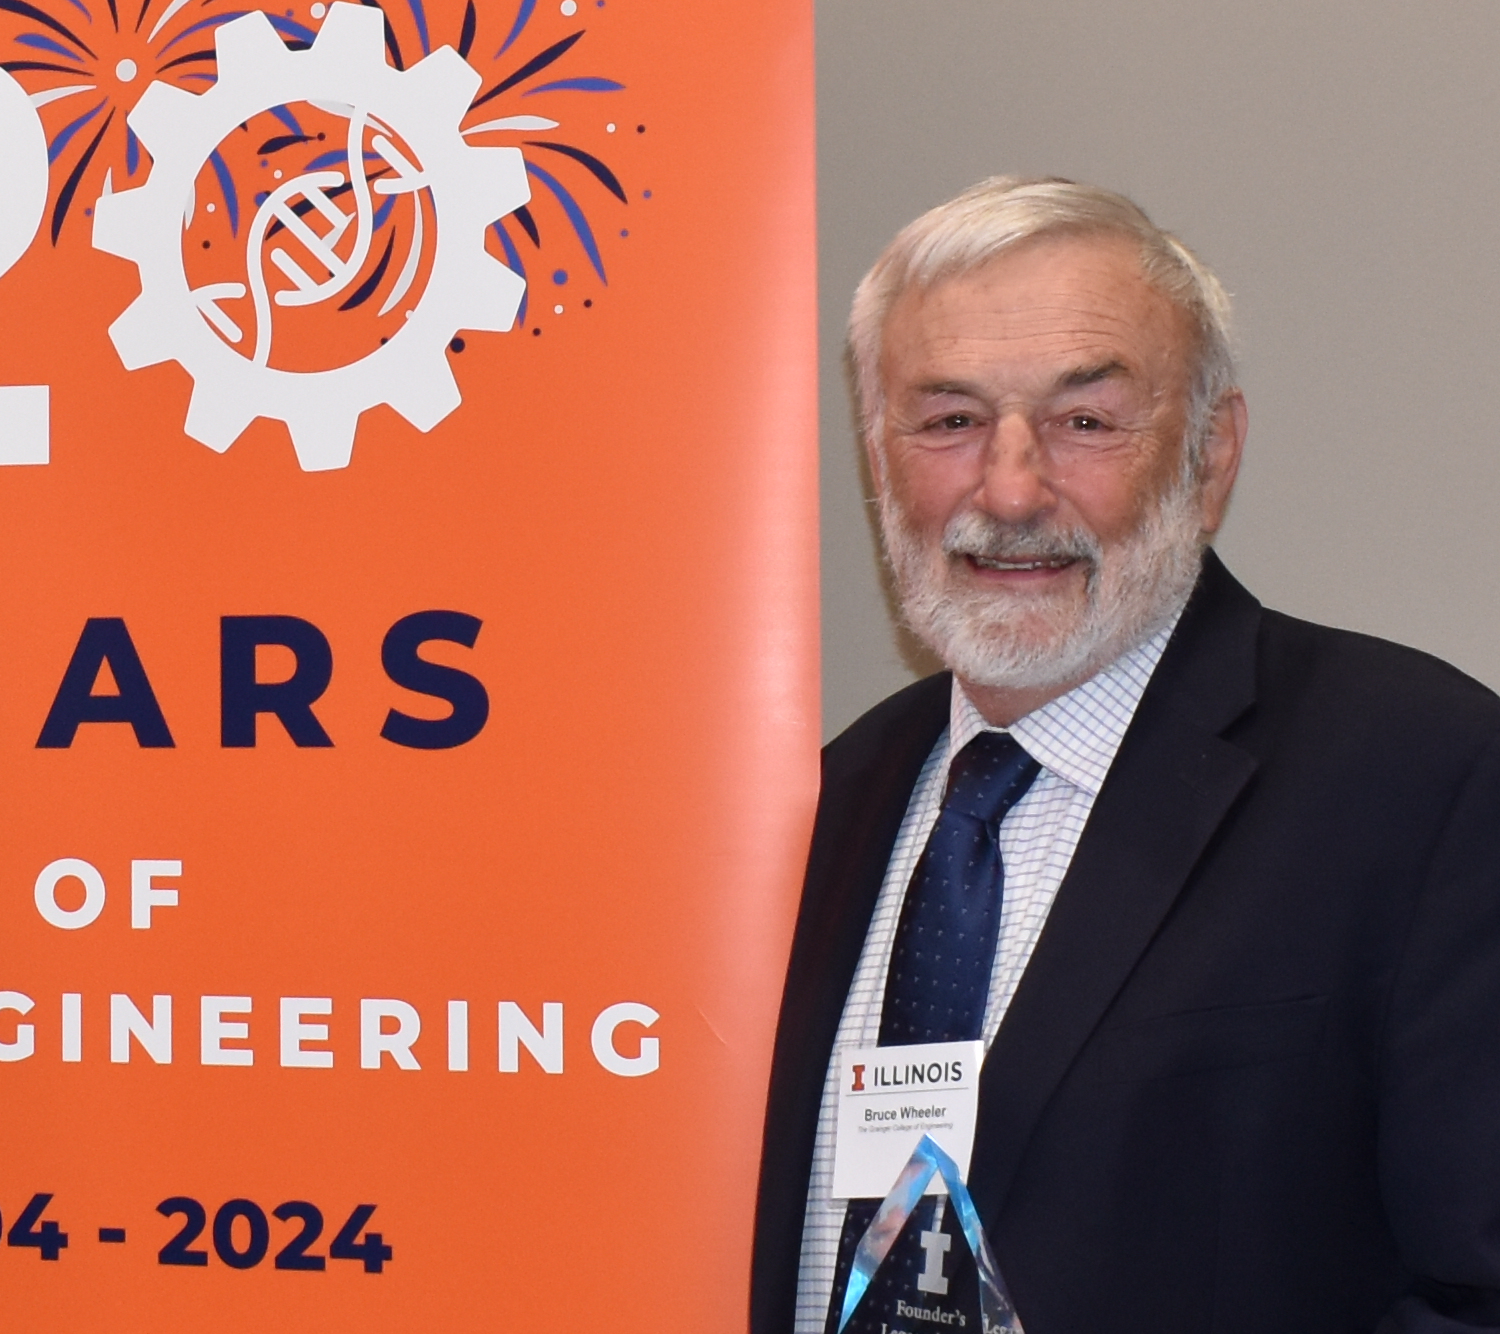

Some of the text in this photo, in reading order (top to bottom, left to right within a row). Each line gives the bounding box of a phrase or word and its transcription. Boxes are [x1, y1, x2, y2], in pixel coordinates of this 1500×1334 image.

[33, 857, 184, 930] OF
[874, 1061, 962, 1087] ILLINOIS
[864, 1105, 946, 1122] Bruce Wheeler
[155, 1197, 393, 1274] 2024
[896, 1299, 966, 1327] Founder's
